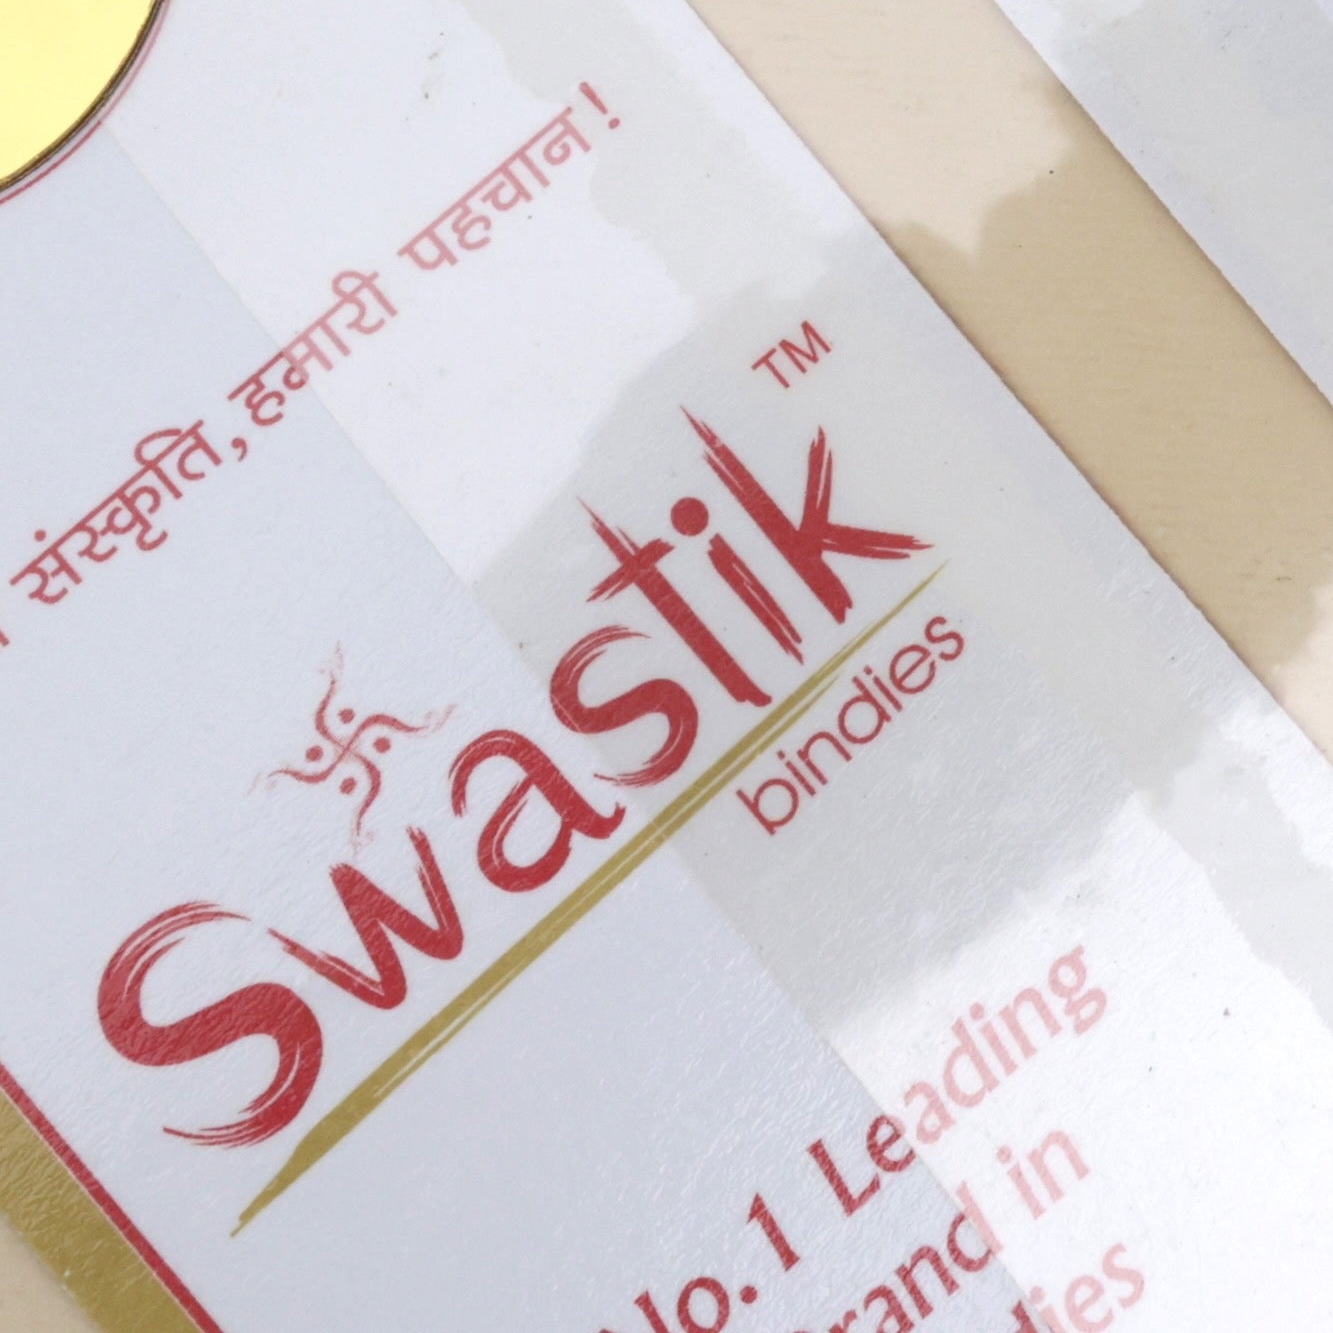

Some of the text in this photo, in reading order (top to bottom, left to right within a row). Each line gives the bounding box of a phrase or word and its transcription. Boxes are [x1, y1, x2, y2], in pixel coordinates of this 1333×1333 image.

[96, 319, 934, 1149] Swastik TM
[736, 614, 967, 837] bindies
[747, 1192, 800, 1271] 1
[806, 945, 1109, 1219] Leading
[996, 1129, 1091, 1220] in
